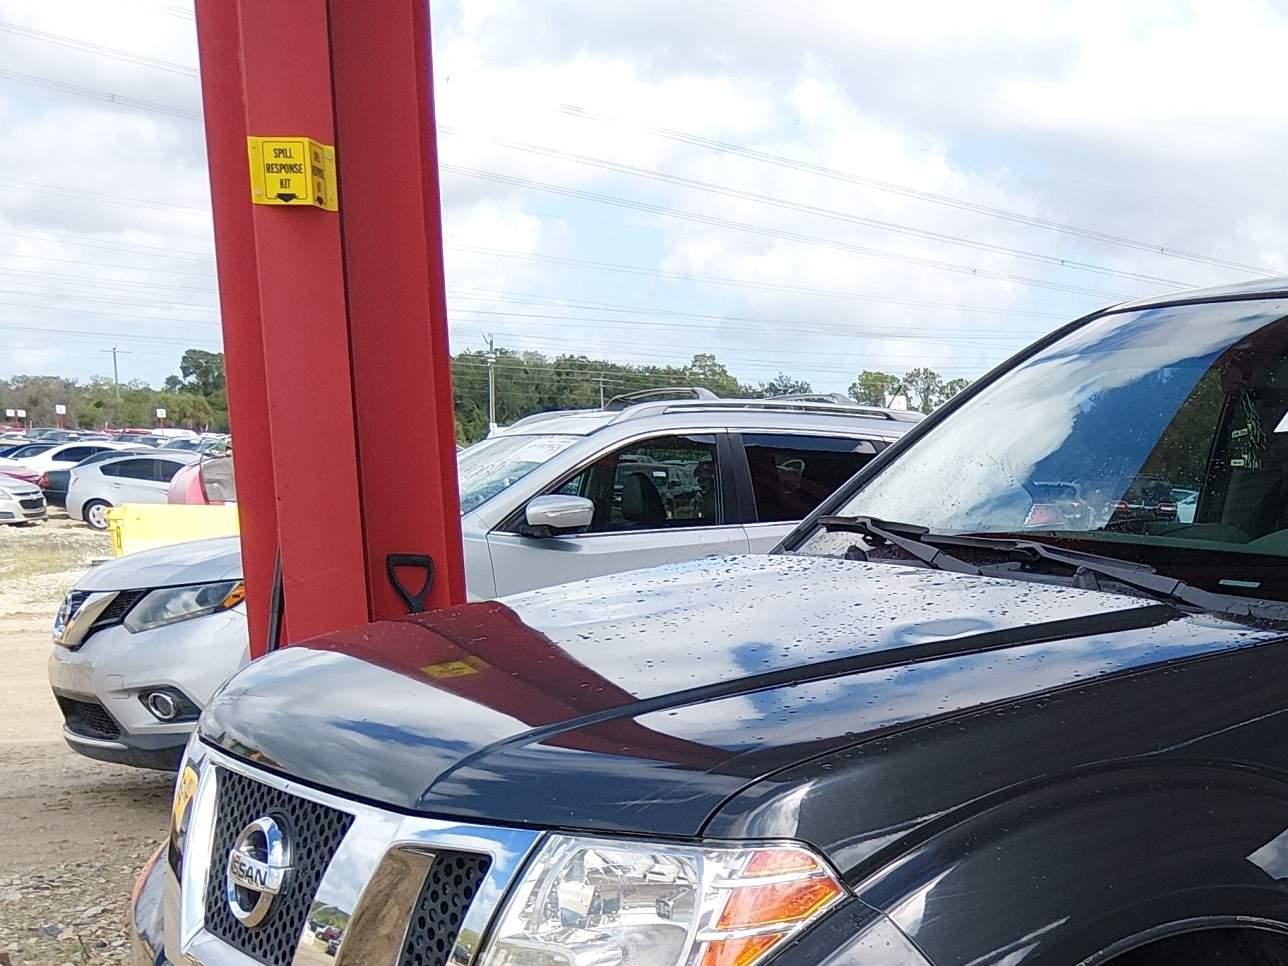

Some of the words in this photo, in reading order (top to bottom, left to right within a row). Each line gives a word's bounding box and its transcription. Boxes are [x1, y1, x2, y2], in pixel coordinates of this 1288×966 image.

[273, 147, 294, 159] SPILL
[265, 163, 304, 175] RESPONSE
[279, 178, 291, 189] KIT
